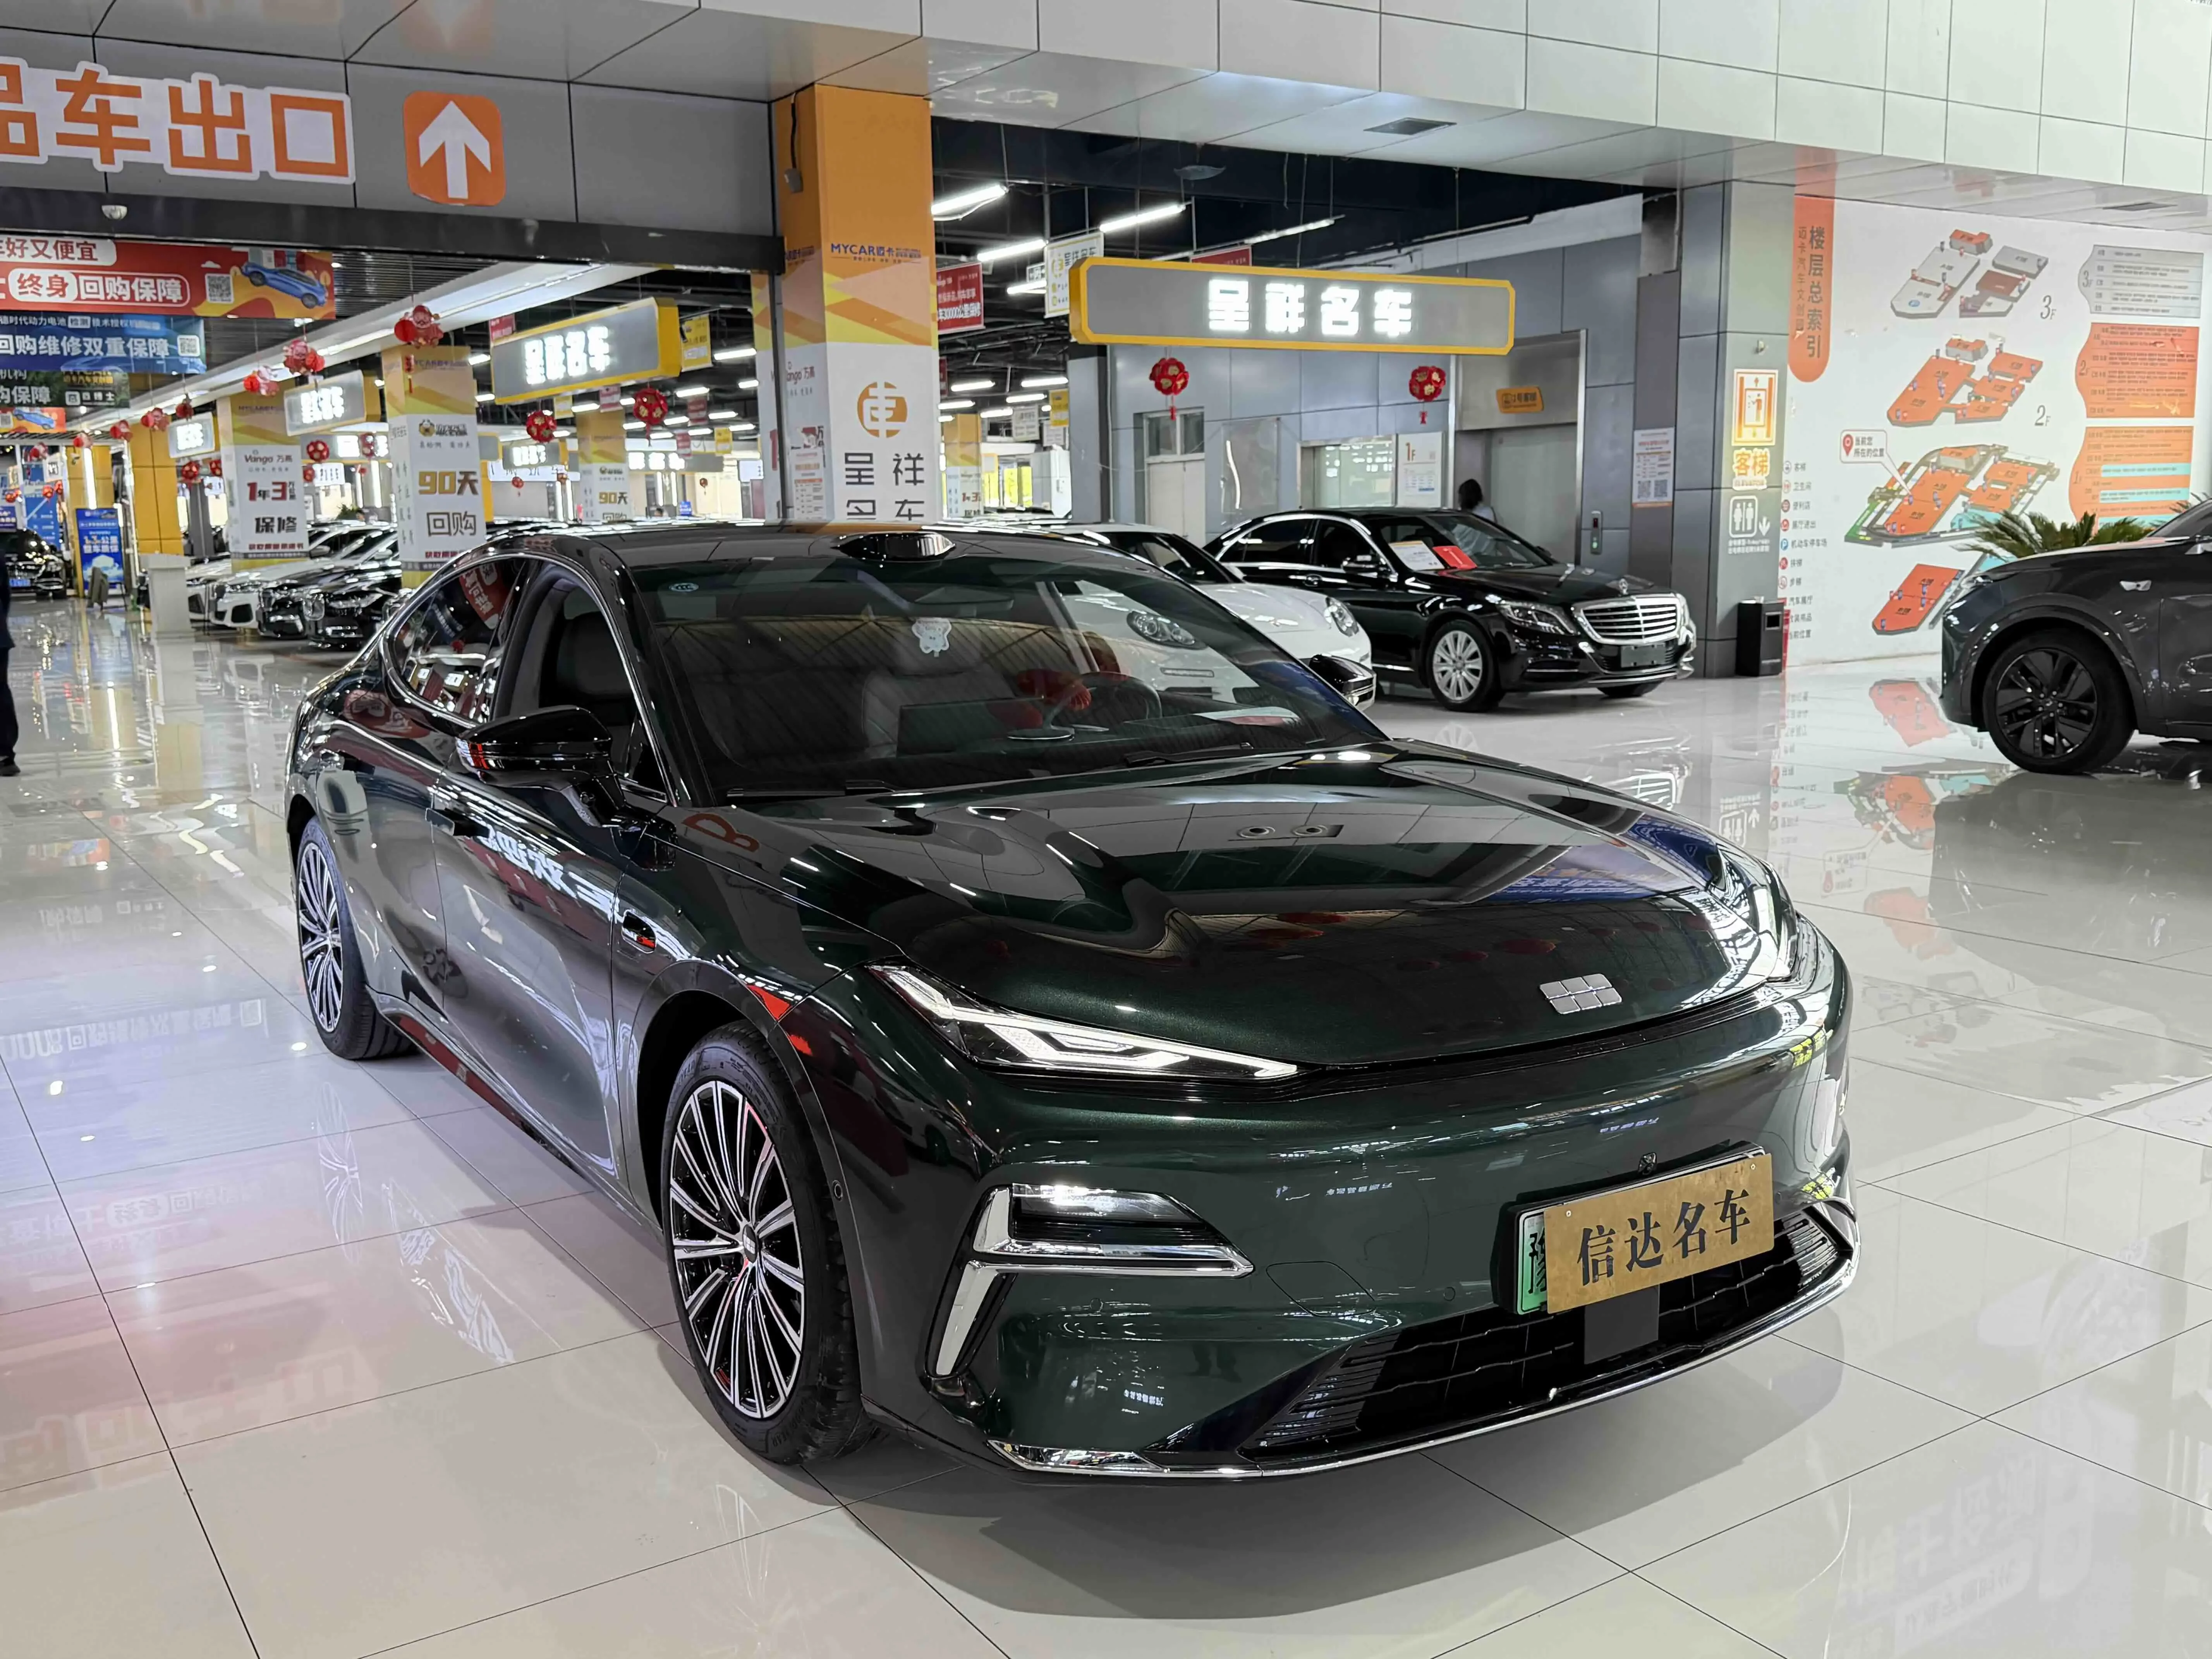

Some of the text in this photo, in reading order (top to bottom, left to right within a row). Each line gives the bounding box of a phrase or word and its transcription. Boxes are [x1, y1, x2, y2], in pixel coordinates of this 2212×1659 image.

[0, 237, 98, 262] 好又便宜
[1807, 226, 1825, 358] 楼层总索引
[1209, 279, 1413, 337] 呈祥名车
[845, 452, 924, 486] 呈祥
[1734, 451, 1769, 477] 客梯
[419, 471, 479, 496] 90天
[255, 516, 297, 534] 保修
[426, 511, 476, 537] 回购
[1577, 1189, 1750, 1286] 信达名车
